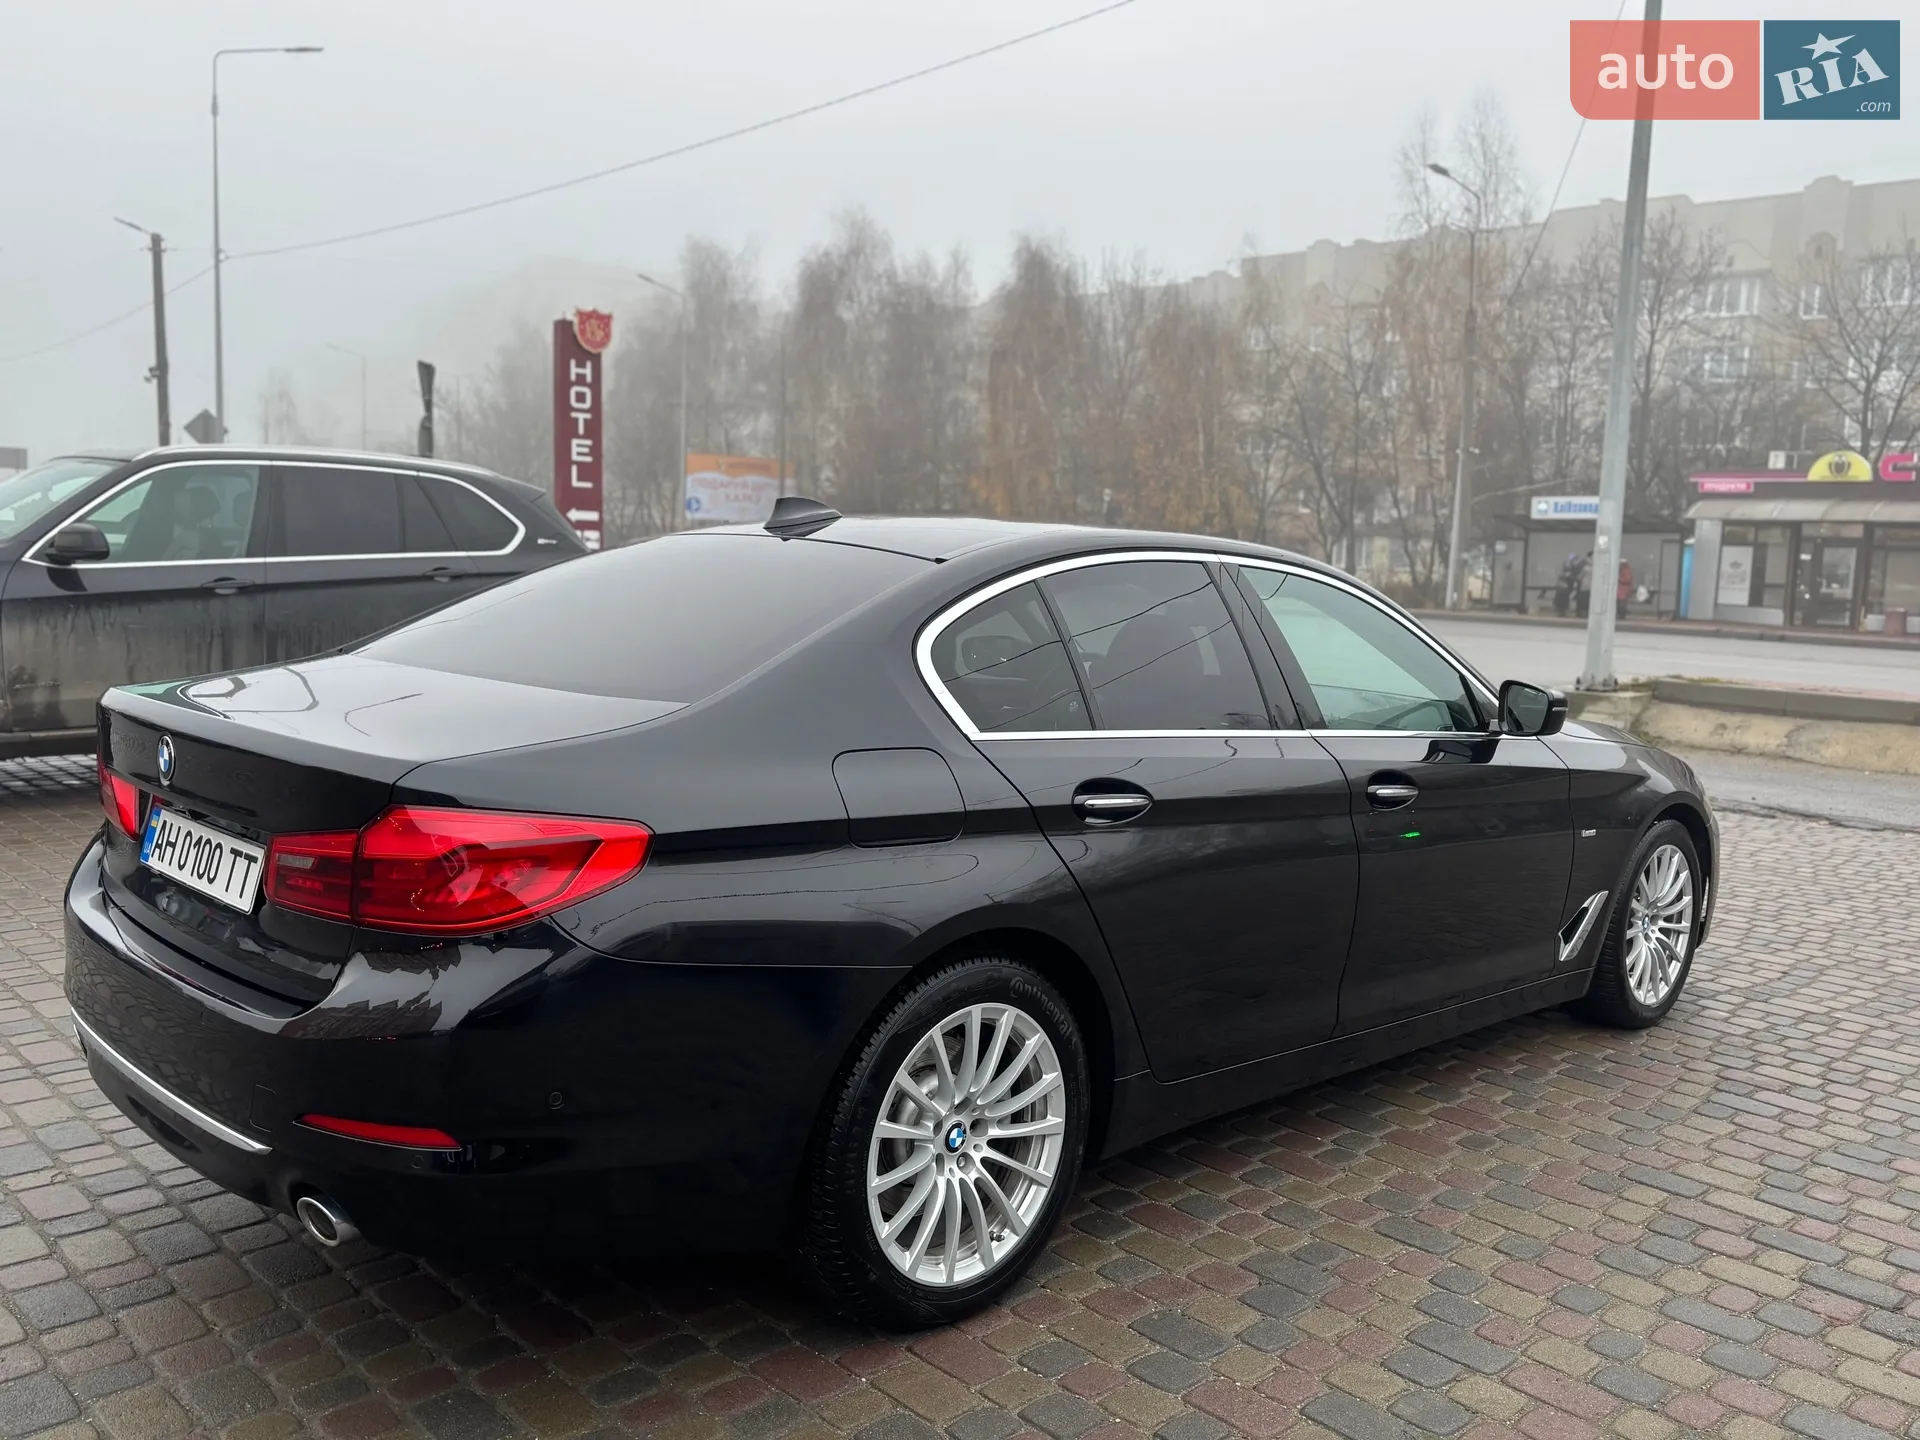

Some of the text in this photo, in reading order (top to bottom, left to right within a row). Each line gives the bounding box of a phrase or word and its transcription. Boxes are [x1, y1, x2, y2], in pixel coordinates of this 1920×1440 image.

[569, 358, 593, 488] HOTEL
[151, 819, 259, 899] AH 0100 TT
[1010, 976, 1072, 1040] Continental
